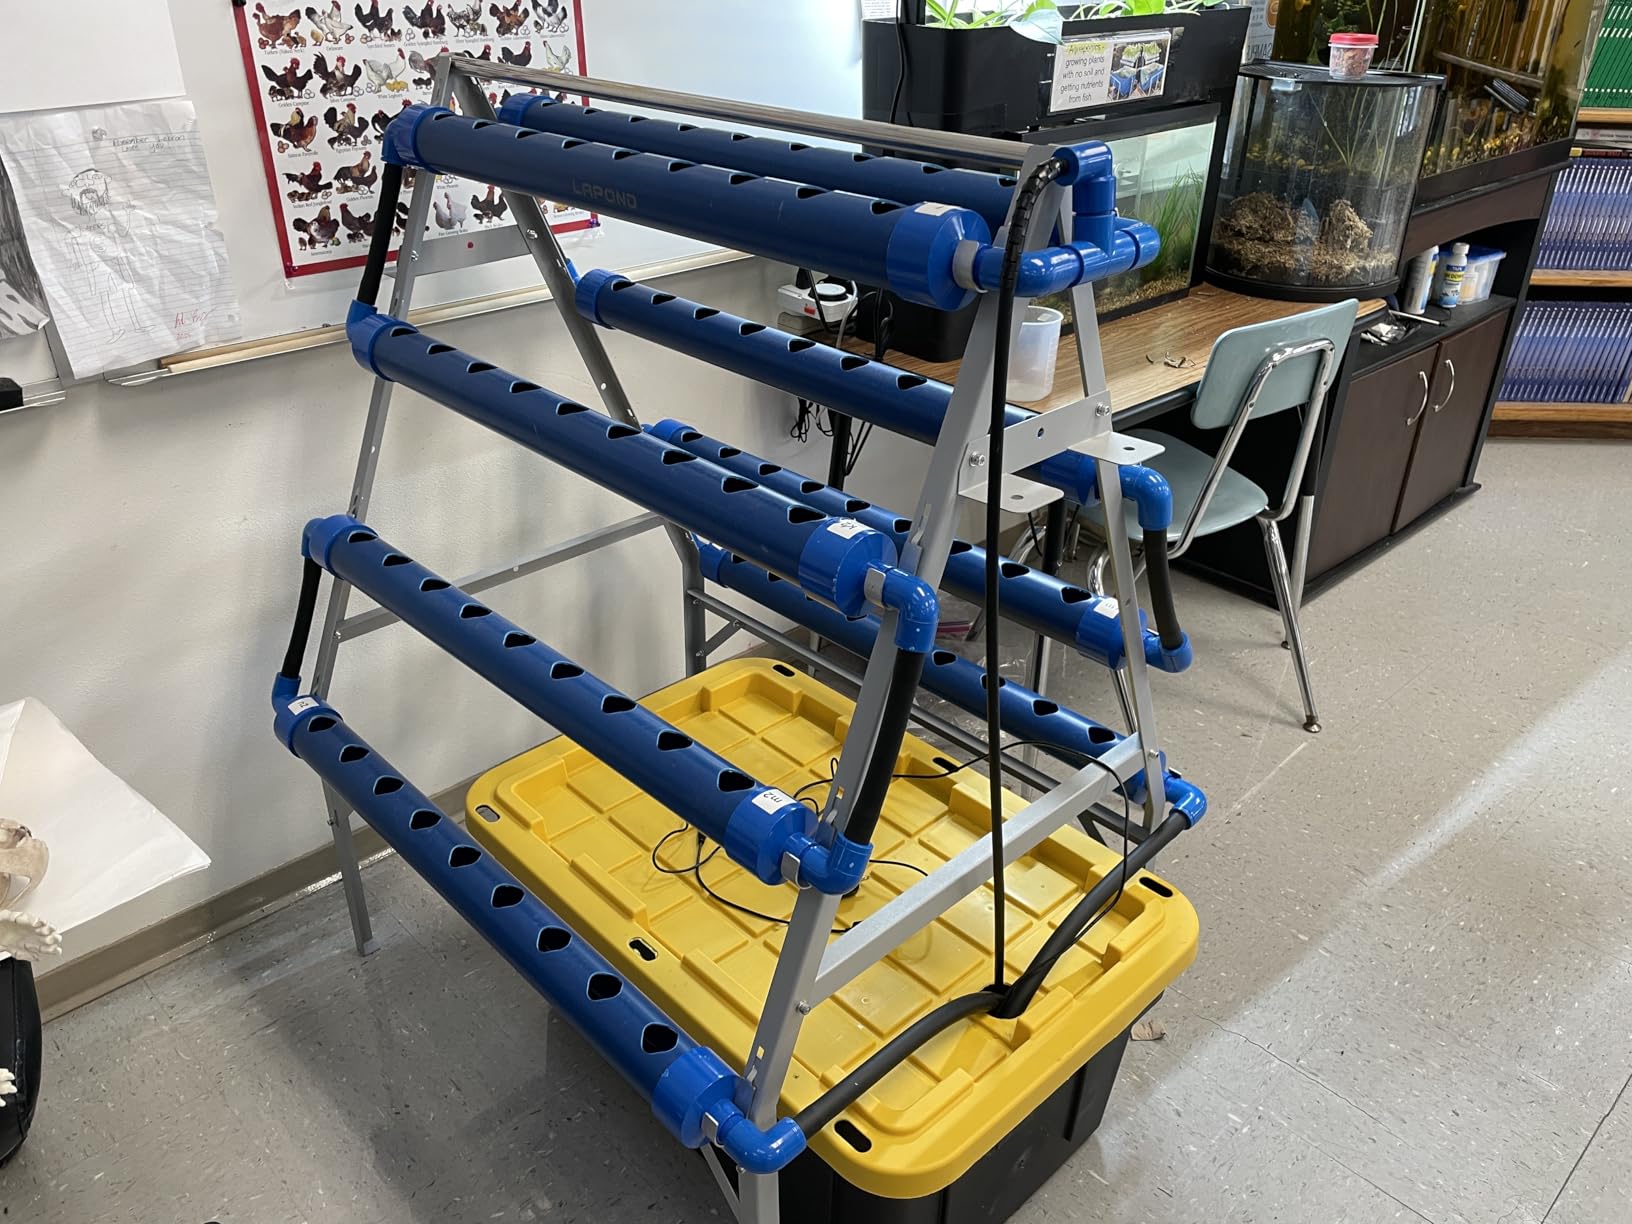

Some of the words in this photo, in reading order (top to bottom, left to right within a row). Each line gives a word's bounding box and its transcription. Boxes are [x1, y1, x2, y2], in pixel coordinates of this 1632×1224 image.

[1065, 57, 1088, 69] growing
[1088, 55, 1105, 66] plants
[1062, 70, 1074, 79] with
[1083, 68, 1094, 77] soil
[1094, 67, 1105, 76] and
[1060, 83, 1080, 94] getting
[1080, 80, 1104, 90] nutrients
[1068, 94, 1082, 103] from
[1082, 93, 1092, 102] fish
